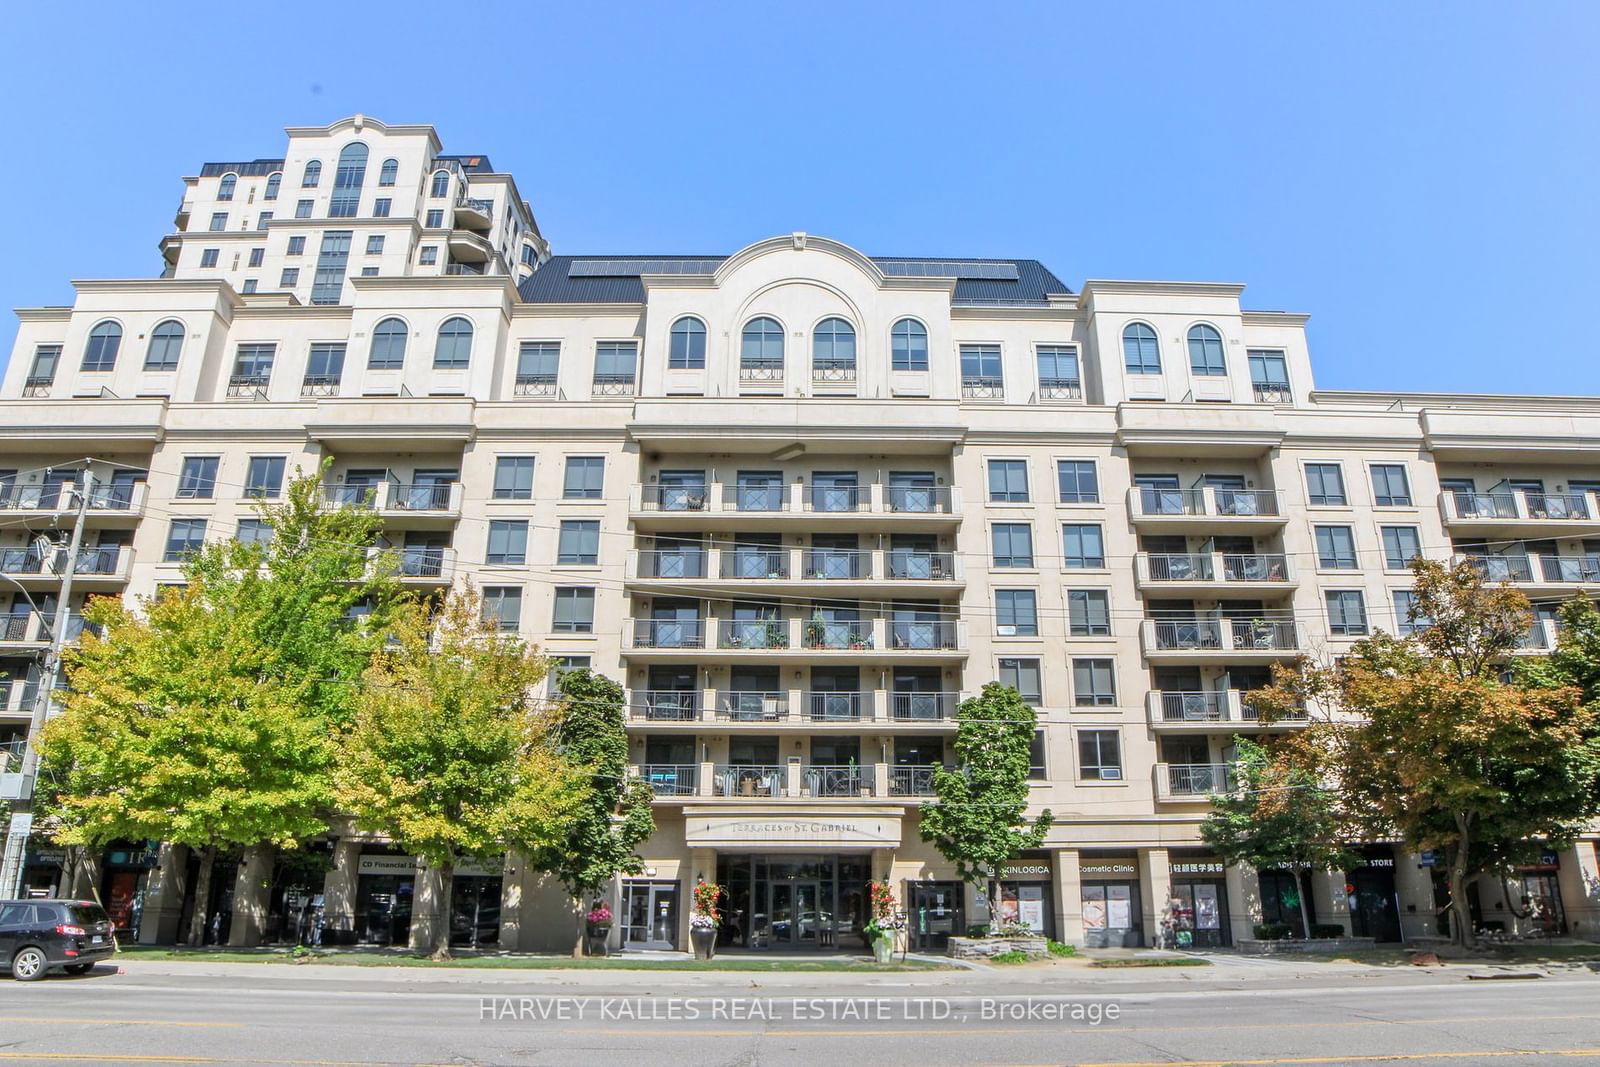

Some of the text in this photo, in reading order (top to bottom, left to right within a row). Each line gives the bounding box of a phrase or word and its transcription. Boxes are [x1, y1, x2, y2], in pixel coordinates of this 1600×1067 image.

[810, 823, 857, 833] GABRIEL
[374, 861, 406, 869] Financial
[1370, 859, 1393, 867] STORE
[1001, 866, 1050, 874] KINLOGICA
[1079, 864, 1135, 873] Cosmetic Clinic
